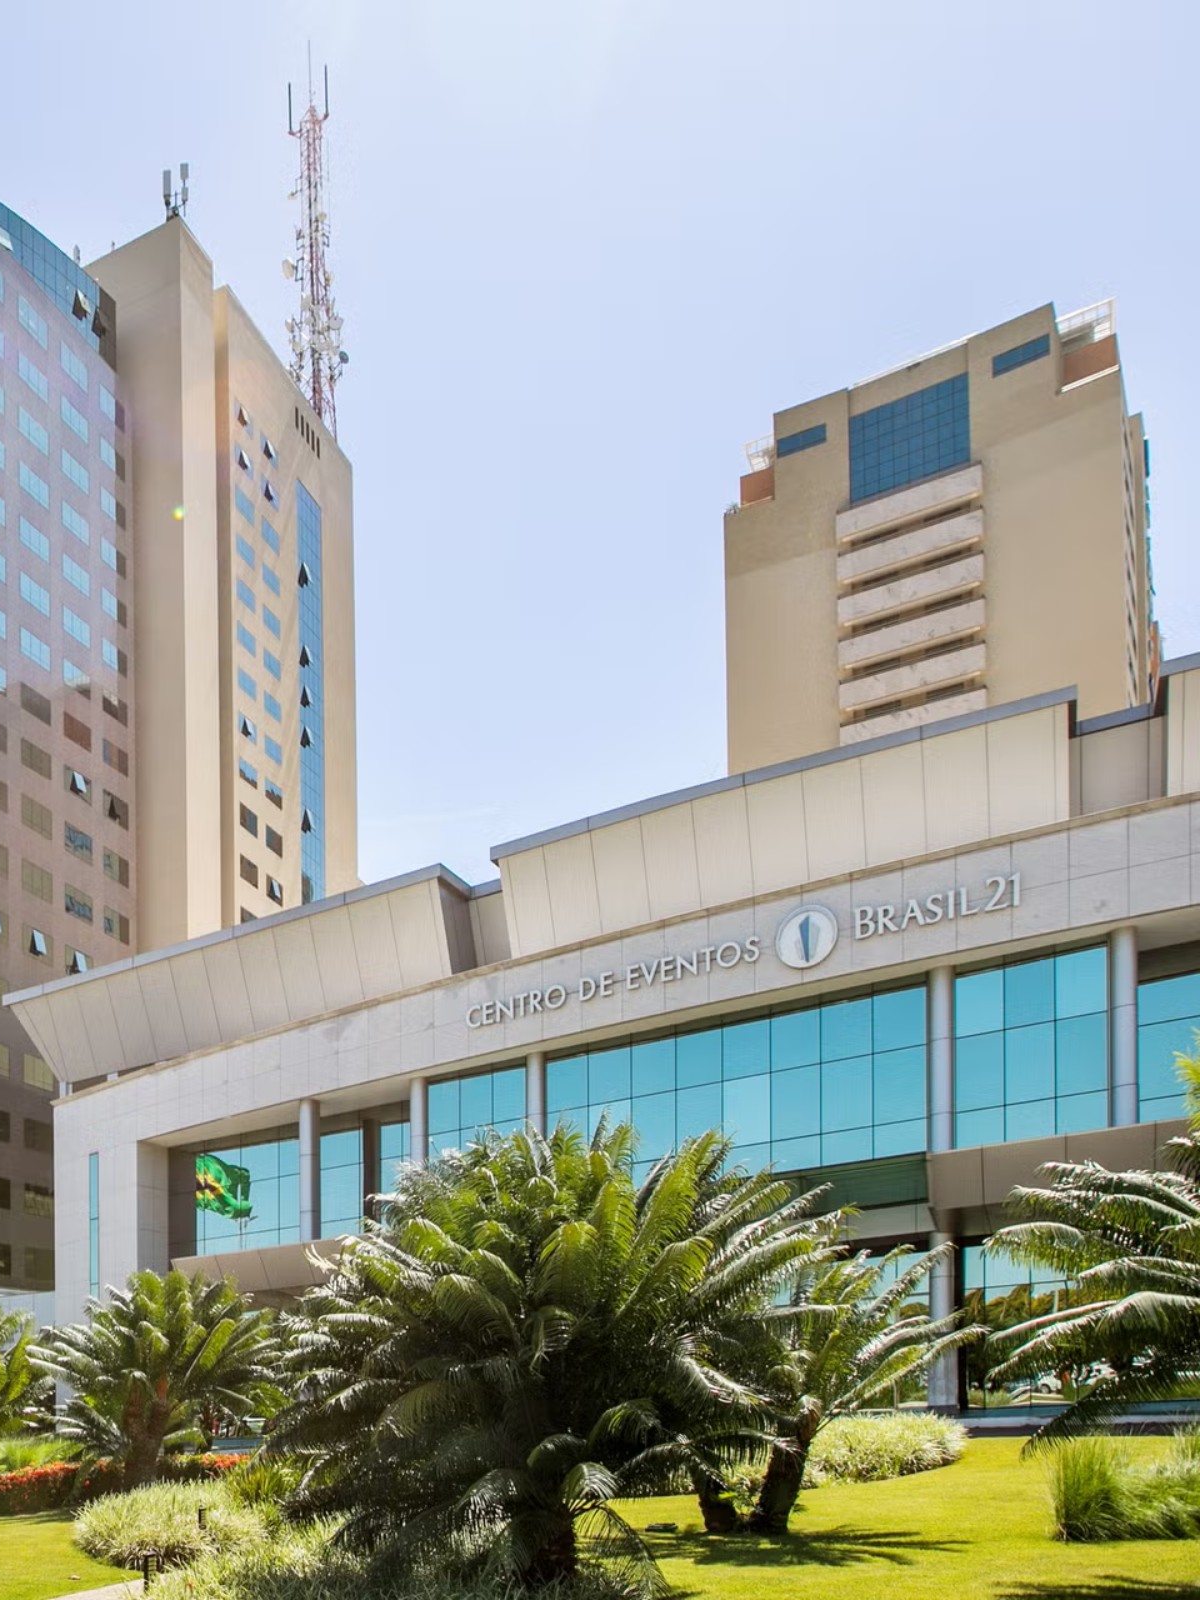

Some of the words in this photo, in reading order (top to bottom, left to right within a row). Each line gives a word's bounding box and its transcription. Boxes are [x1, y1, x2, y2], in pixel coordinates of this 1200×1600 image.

[465, 984, 567, 1028] CENTRO
[579, 971, 614, 1001] DE
[626, 936, 760, 990] EVENTOS
[854, 887, 980, 940] BRASIL
[984, 872, 1021, 912] 21
